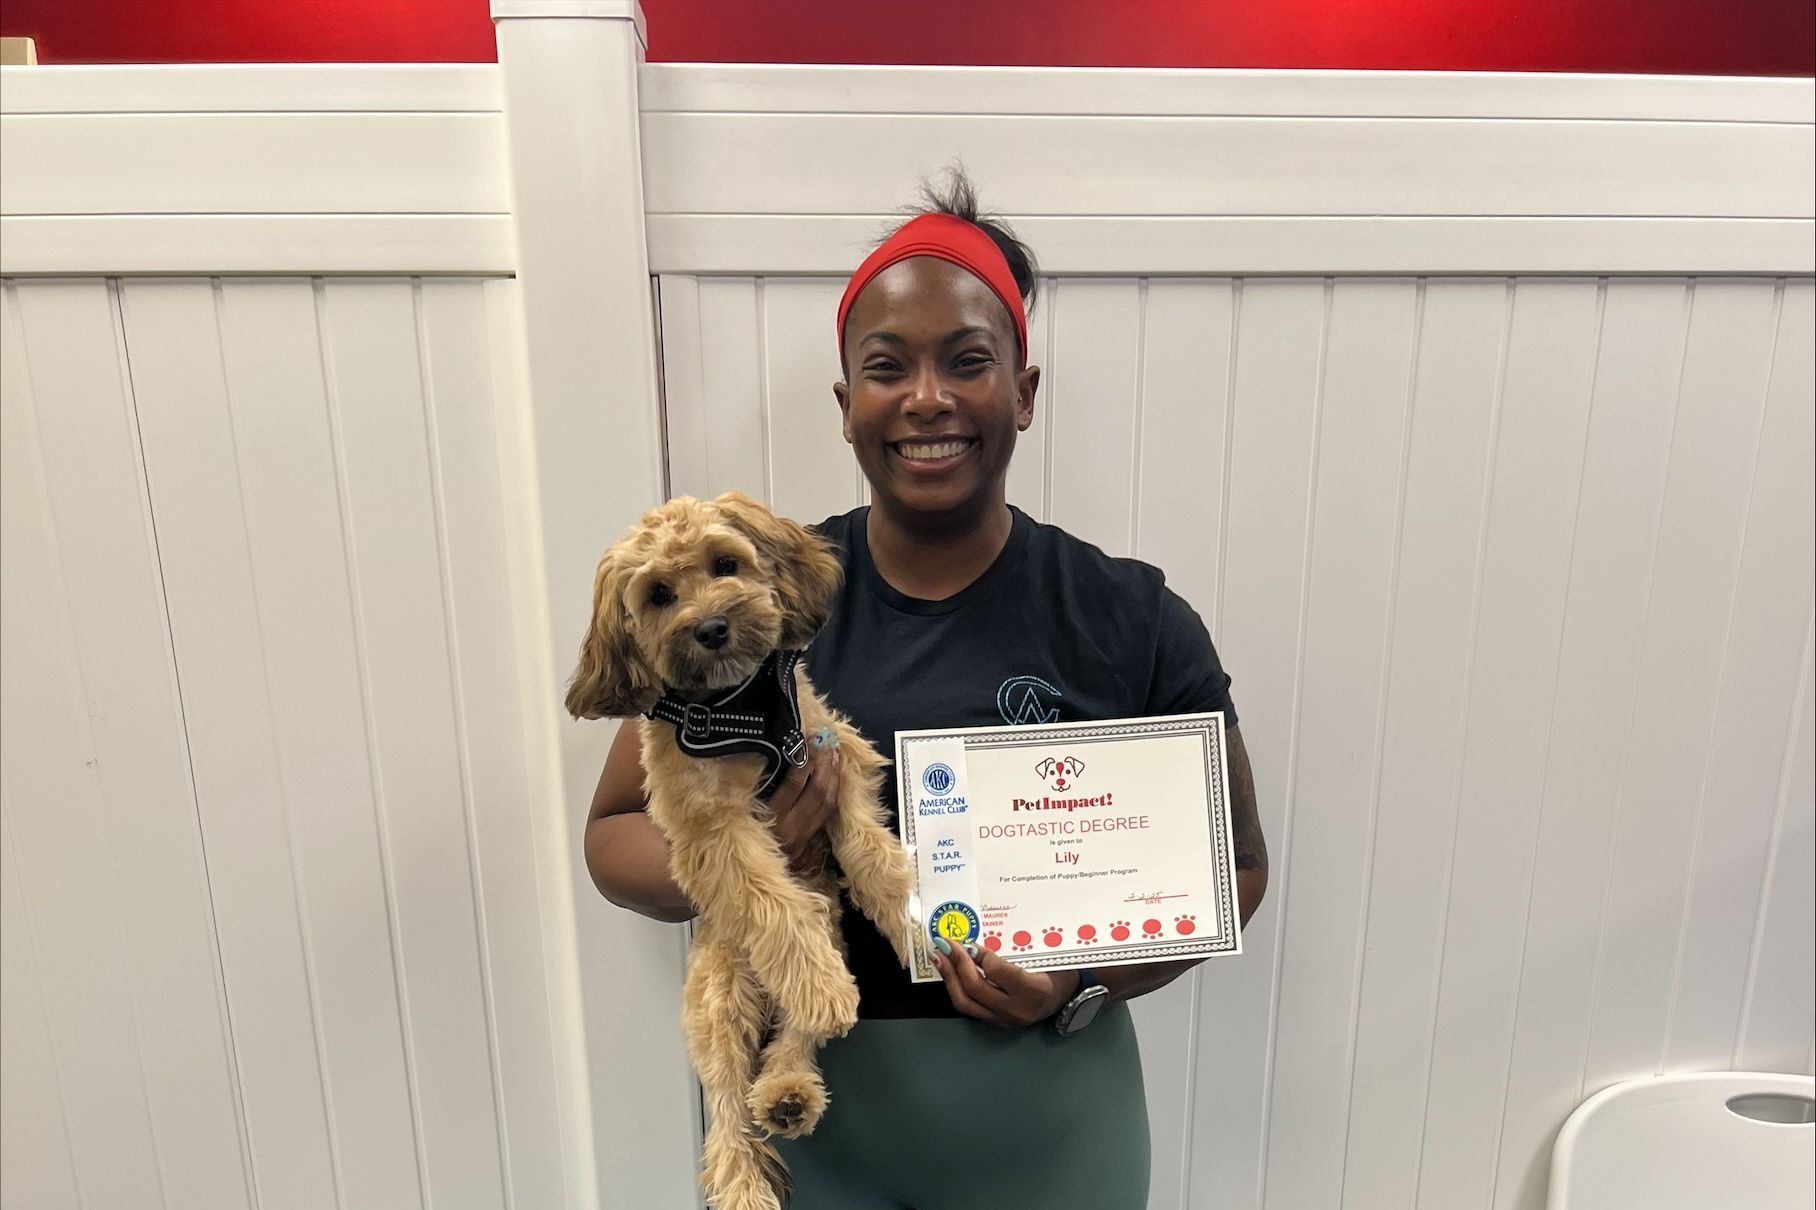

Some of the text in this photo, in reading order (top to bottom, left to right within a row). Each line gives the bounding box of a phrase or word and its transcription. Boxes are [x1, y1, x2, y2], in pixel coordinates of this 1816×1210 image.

[919, 797, 965, 808] AMERICAN
[1012, 793, 1113, 812] PetImpact!
[919, 808, 945, 816] KENNEL
[979, 815, 1150, 839] DOGTASTIC DEGREE
[937, 839, 955, 847] AKC
[1057, 838, 1075, 846] given
[1055, 851, 1080, 865] Lily
[1011, 874, 1048, 882] Completion
[1110, 867, 1138, 876] Program
[937, 903, 960, 914] STAR
[962, 907, 977, 929] PUPPY
